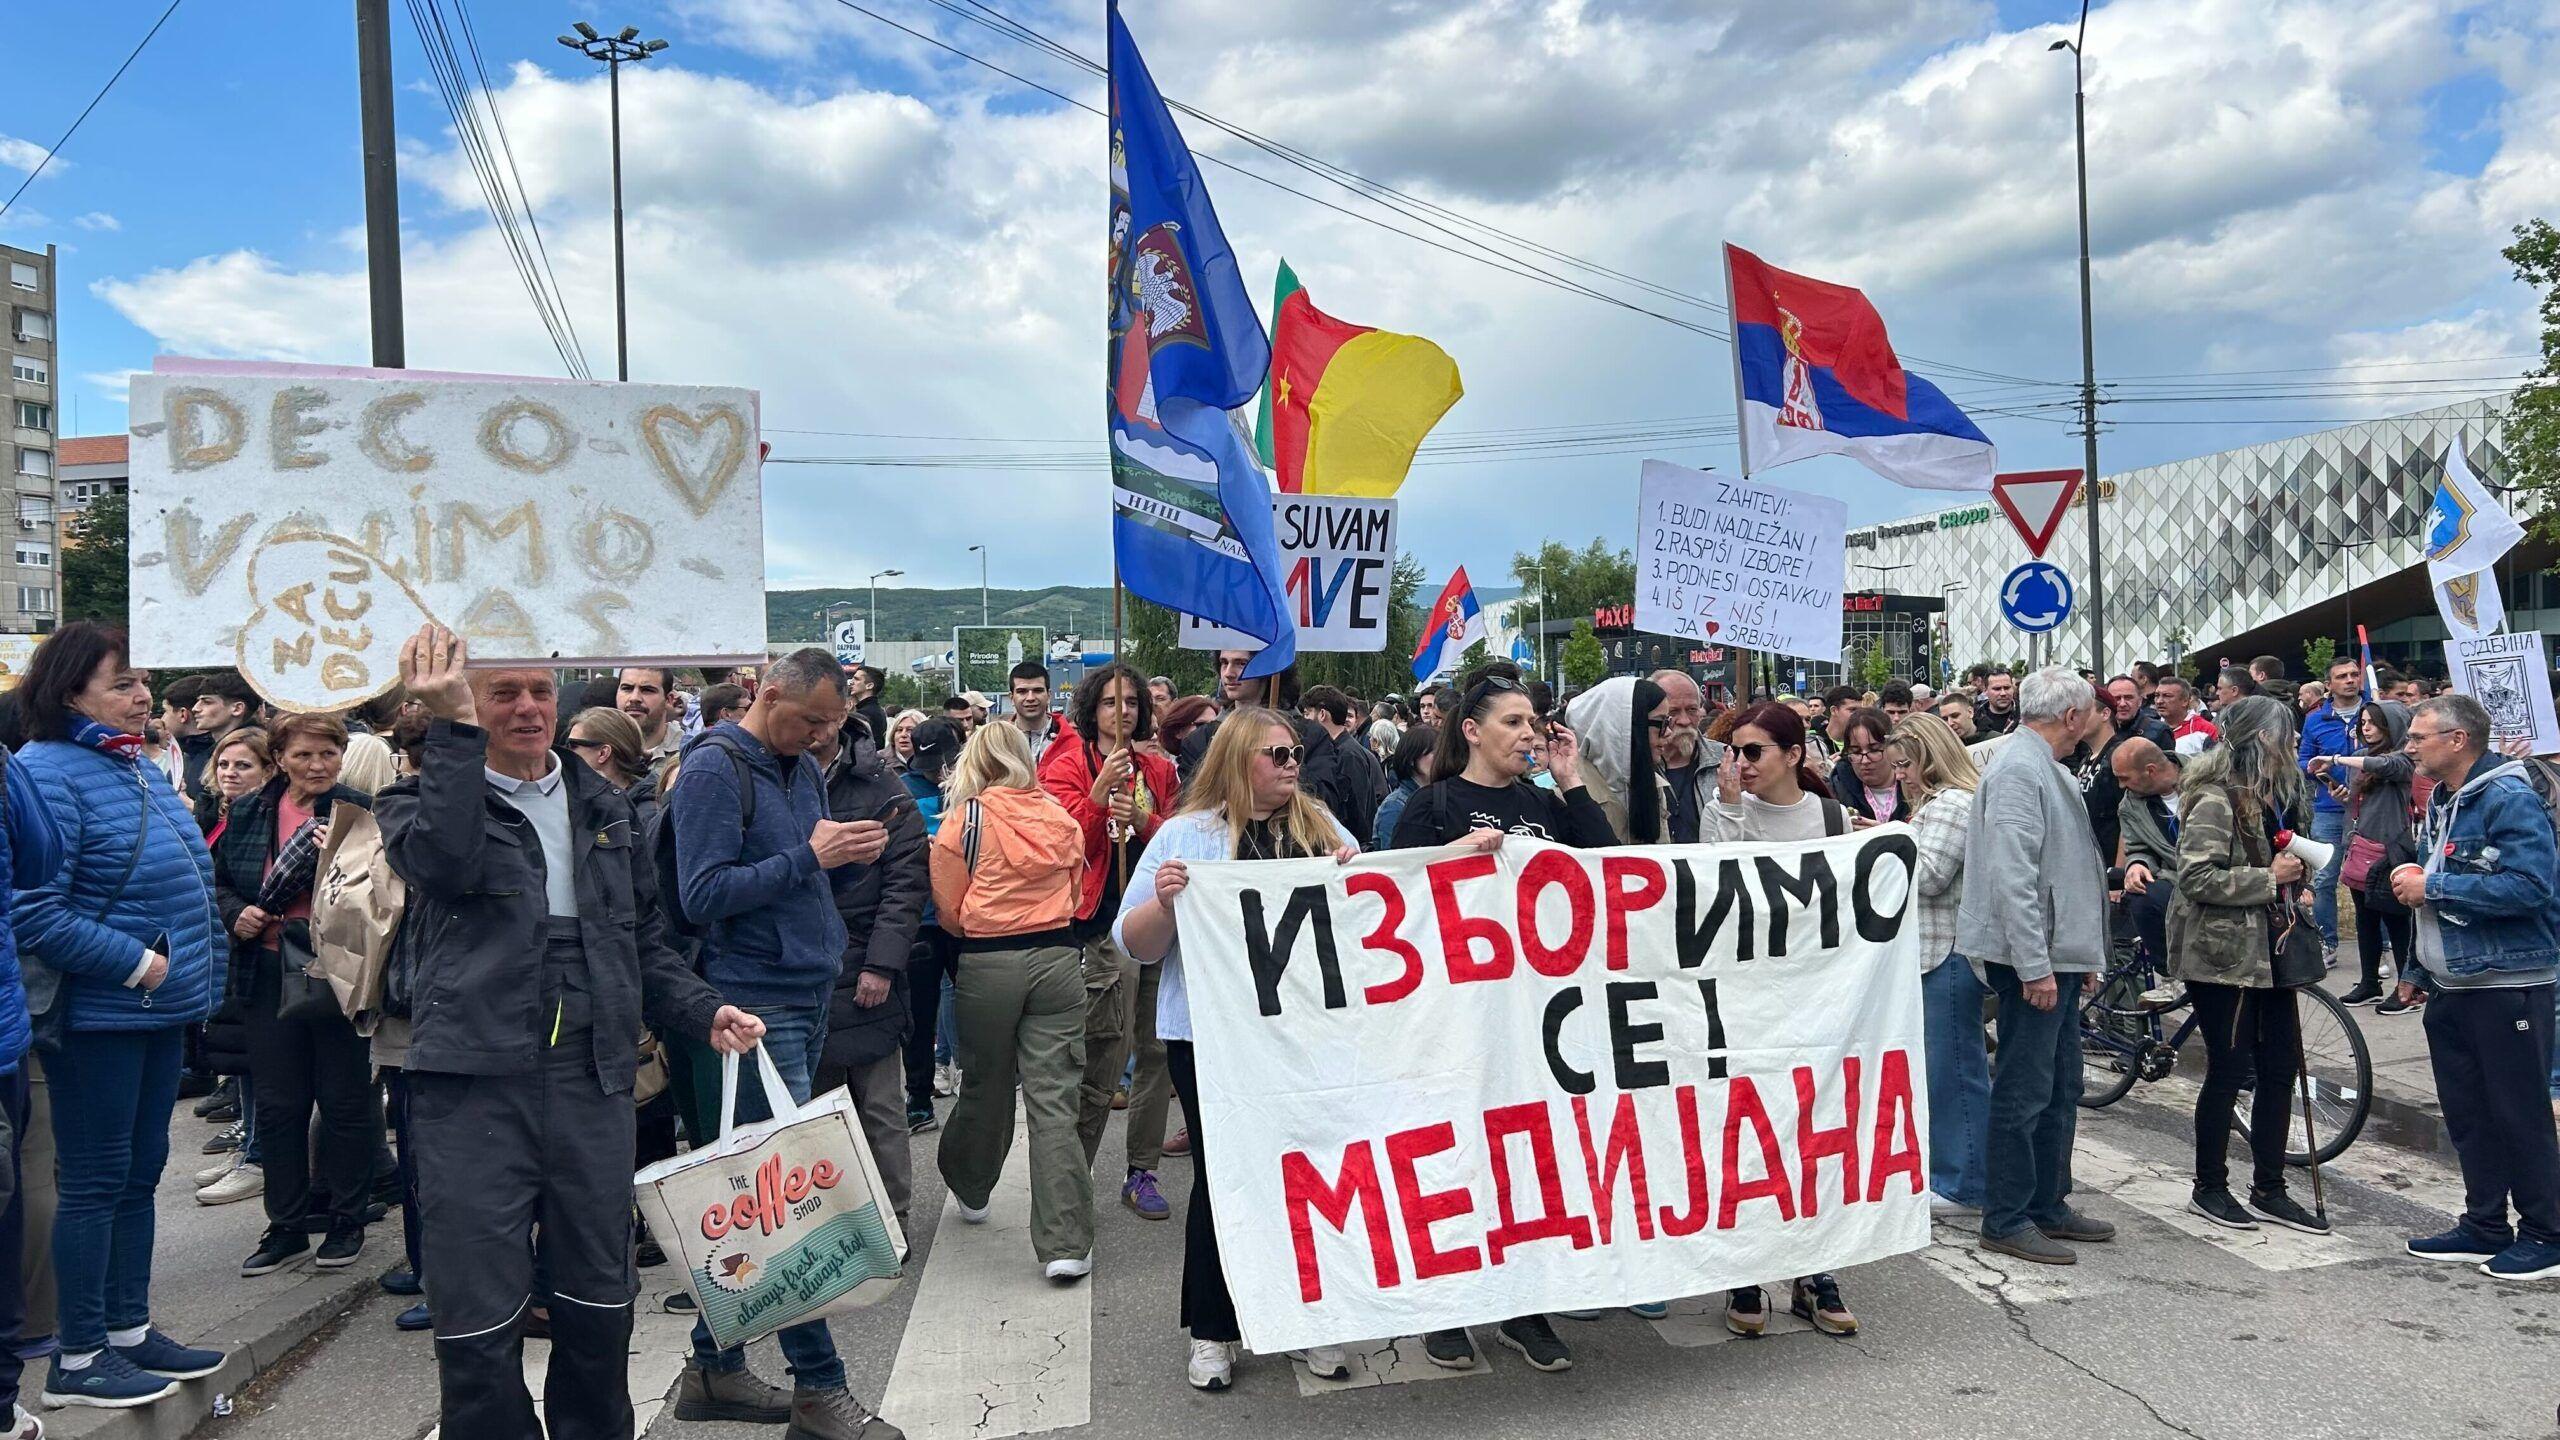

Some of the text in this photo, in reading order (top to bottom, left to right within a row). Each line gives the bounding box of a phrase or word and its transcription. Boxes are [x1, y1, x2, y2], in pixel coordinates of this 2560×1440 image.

[1127, 494, 1181, 522] НИШ
[1716, 482, 1793, 516] ZAHTEVI:
[1671, 502, 1711, 531] BUDI
[1938, 507, 1990, 529] CROPP
[1669, 531, 1732, 564] RASPIŠI
[1666, 560, 1738, 592] PODNESI
[319, 549, 373, 691] DECU
[1693, 594, 1717, 617] IZ
[272, 581, 316, 675] ZA
[1674, 617, 1699, 636] JA
[2459, 633, 2534, 657] СУДБИНА
[1239, 833, 1917, 1016] ИЗБОРИМО
[728, 1175, 750, 1192] THE
[1281, 1048, 1924, 1303] МЕДИЈАНА
[700, 1151, 845, 1241] coffee
[792, 1196, 822, 1222] SHOP
[798, 1254, 845, 1302] always
[737, 1281, 786, 1326] always
